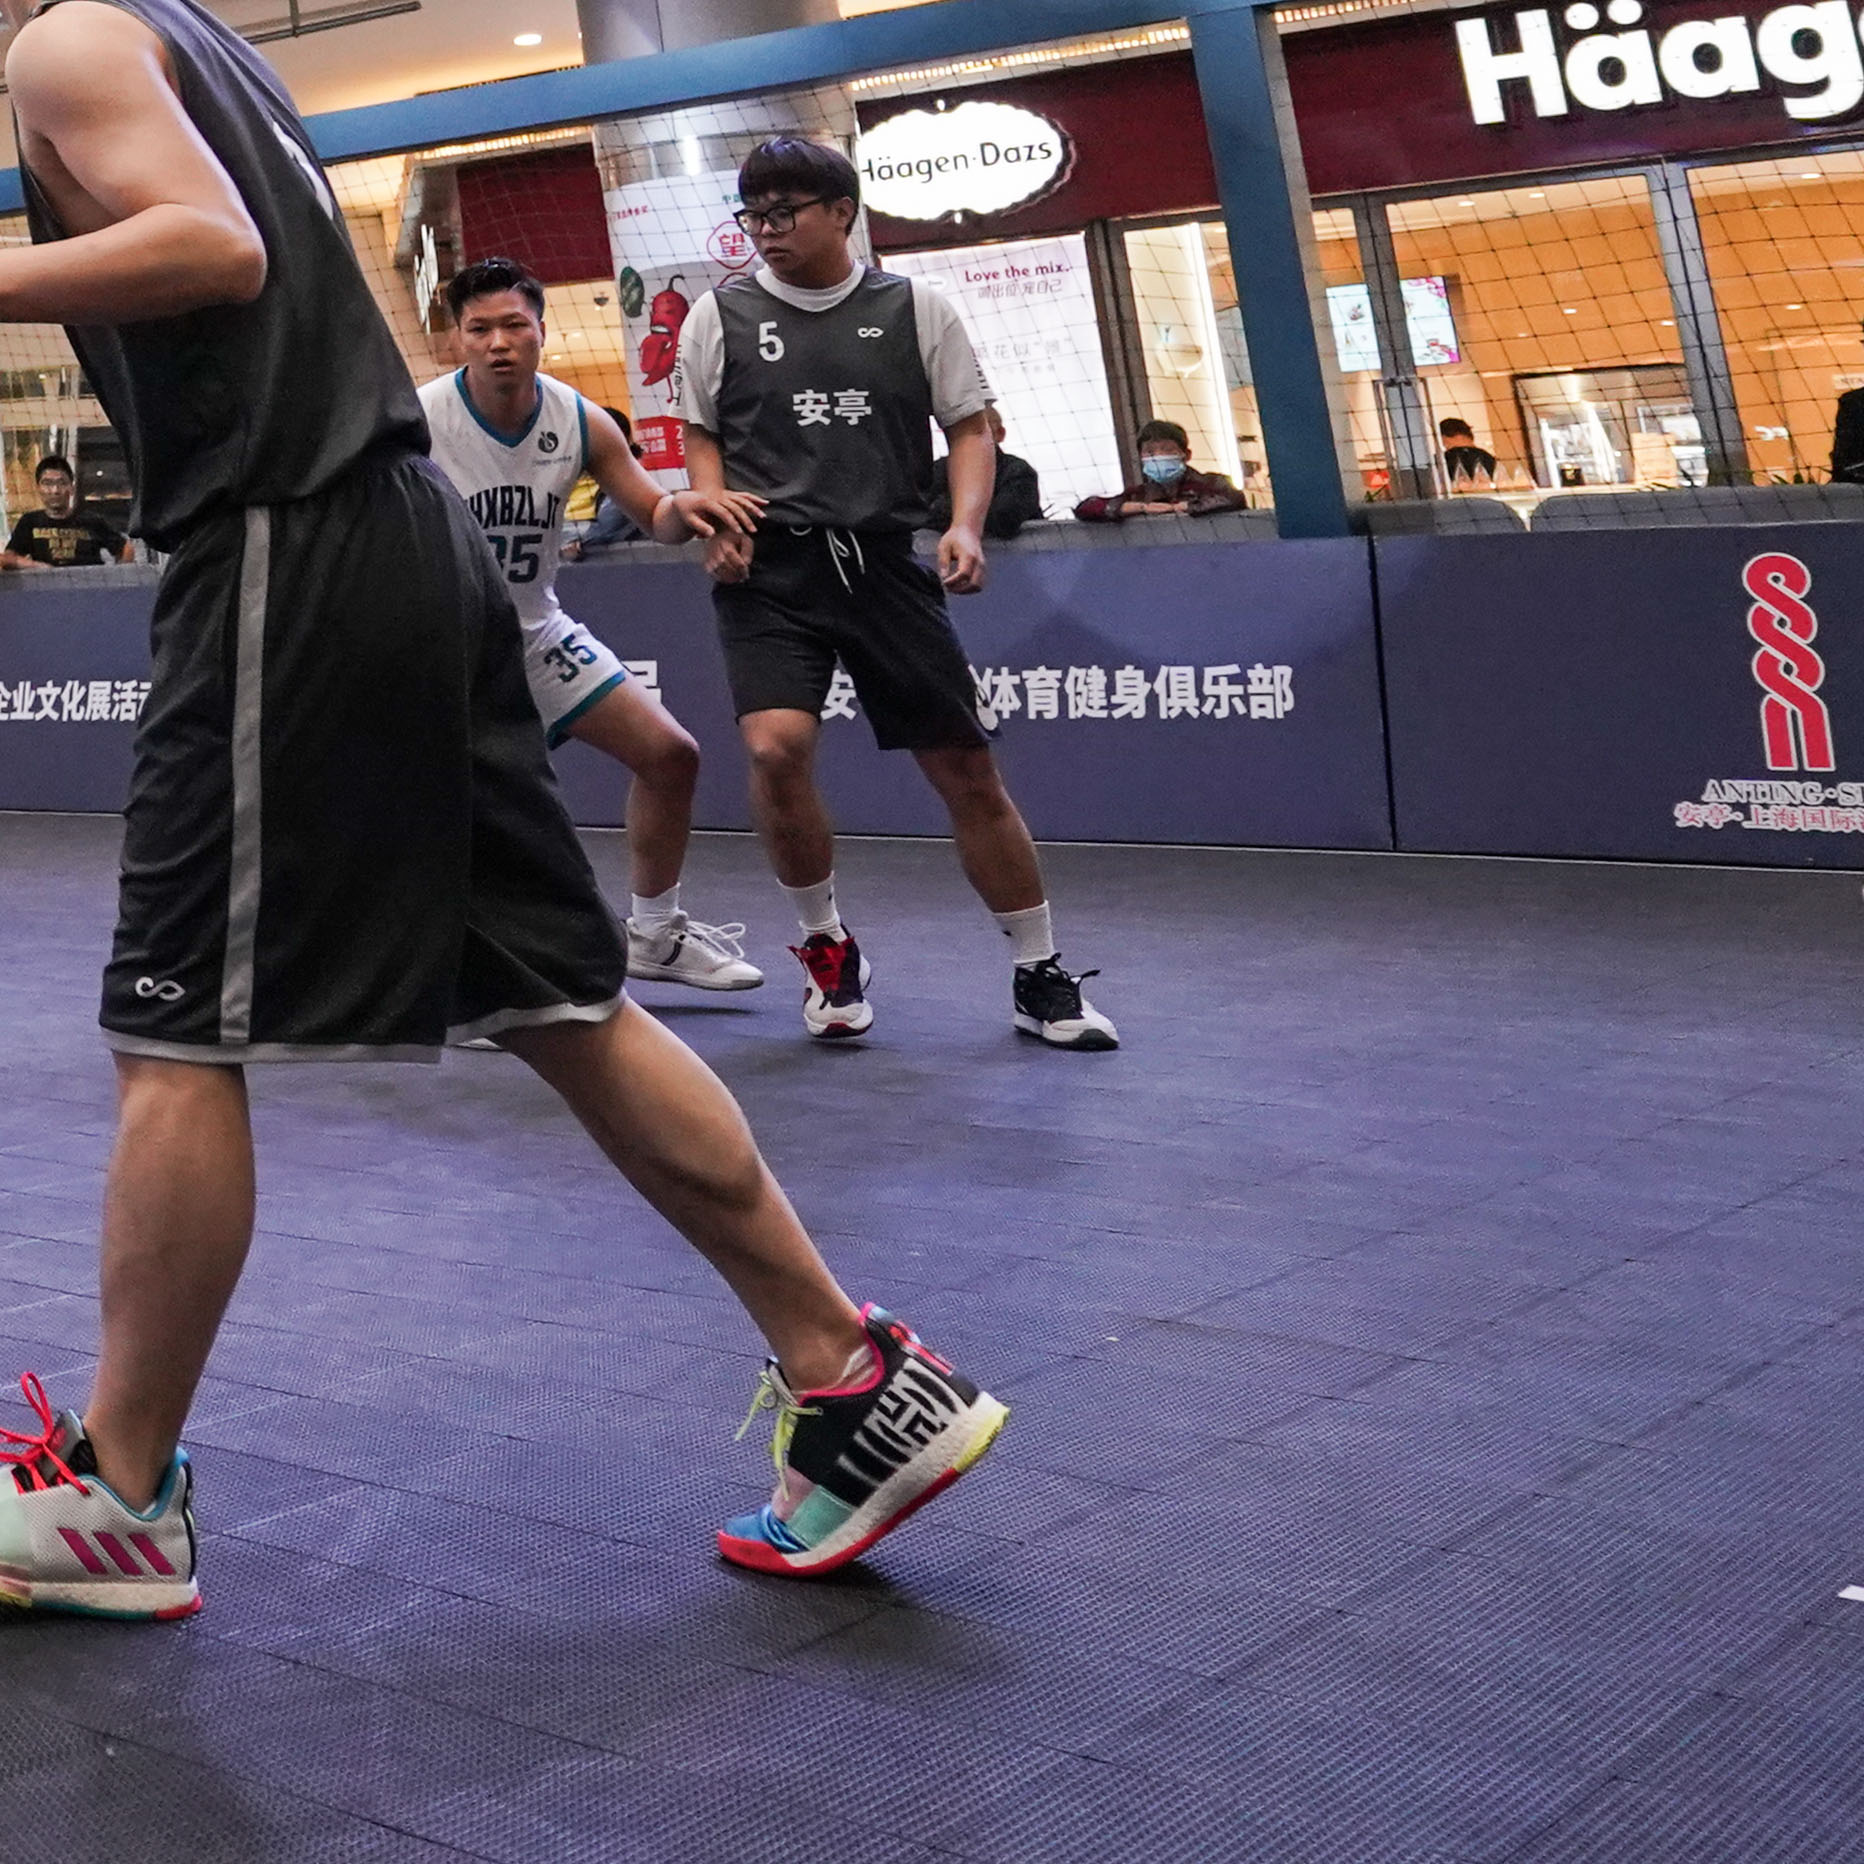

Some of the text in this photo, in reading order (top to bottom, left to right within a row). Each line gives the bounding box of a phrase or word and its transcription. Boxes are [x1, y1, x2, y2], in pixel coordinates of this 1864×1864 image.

[965, 260, 1071, 283] Love the mix.
[757, 321, 786, 364] 5
[791, 388, 873, 428] 安亭
[544, 632, 599, 684] 35
